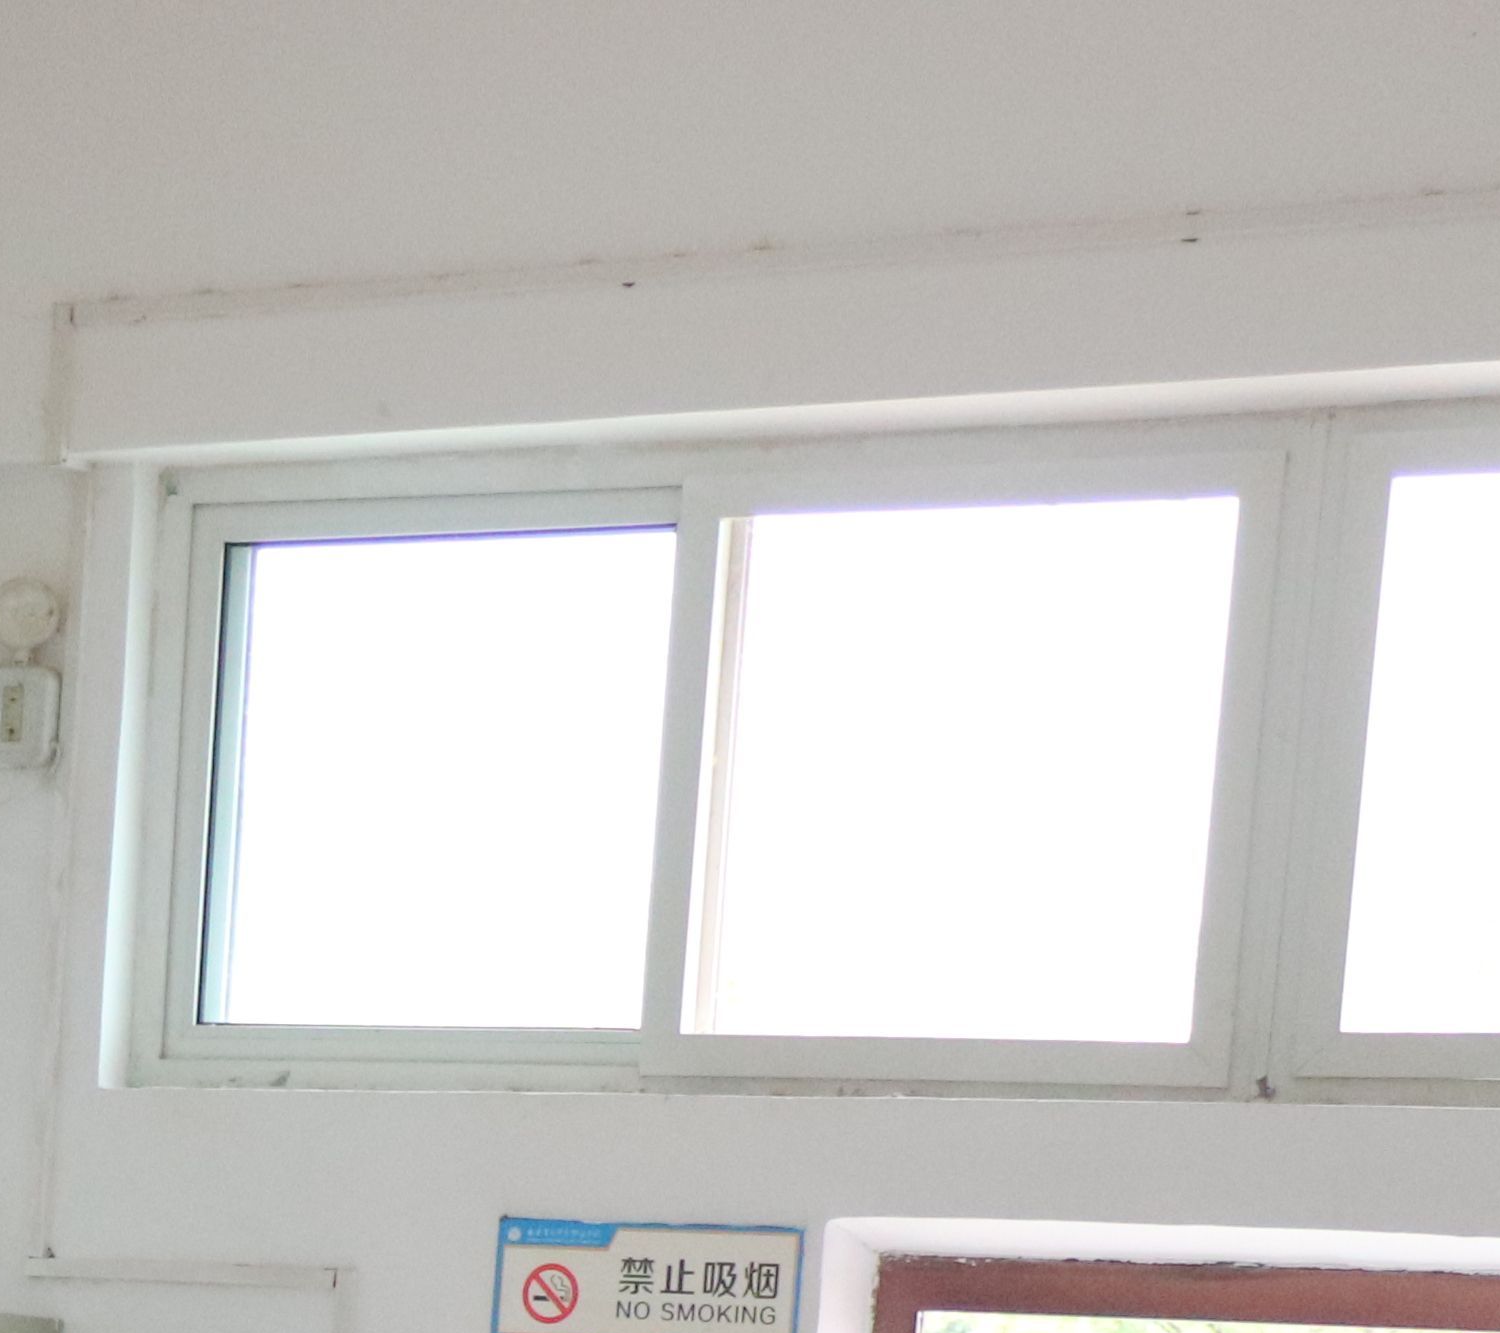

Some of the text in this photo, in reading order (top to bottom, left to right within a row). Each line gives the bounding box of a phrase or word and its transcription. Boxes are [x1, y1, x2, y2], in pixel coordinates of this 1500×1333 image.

[618, 1257, 780, 1300] 禁止吸烟
[615, 1301, 777, 1326] NO SMOKING
